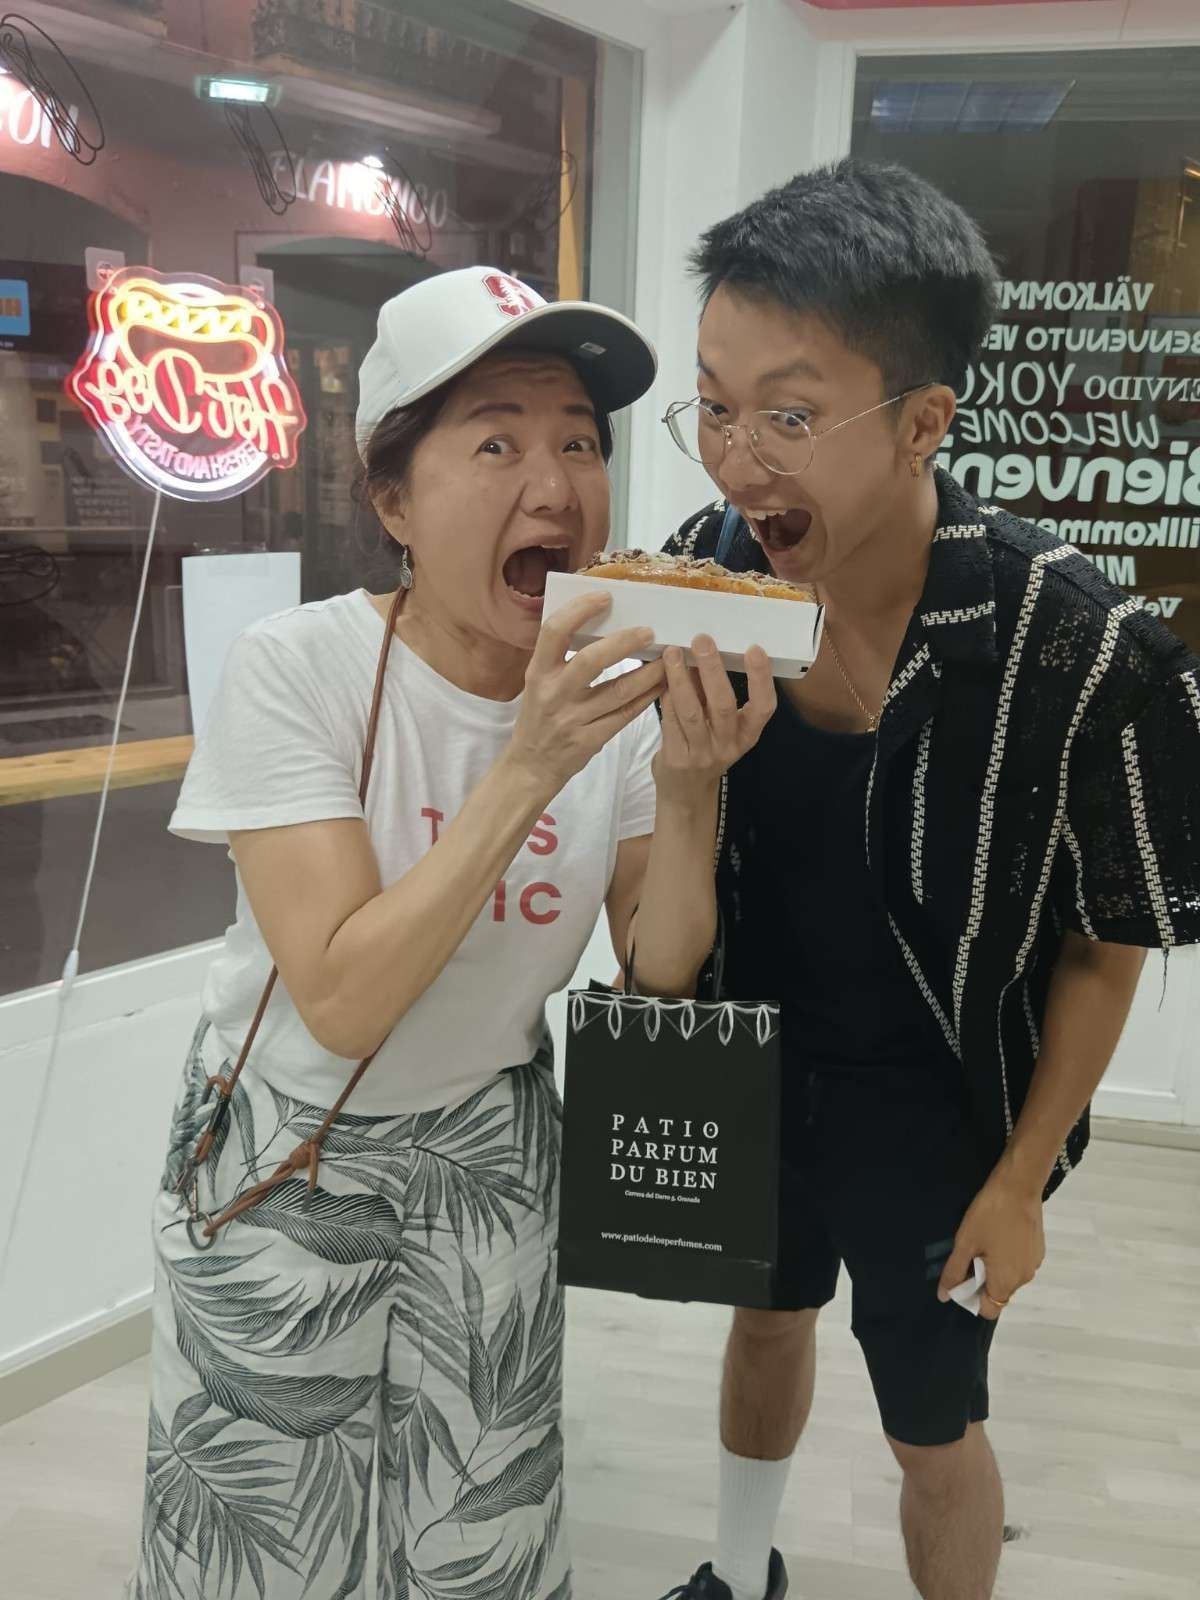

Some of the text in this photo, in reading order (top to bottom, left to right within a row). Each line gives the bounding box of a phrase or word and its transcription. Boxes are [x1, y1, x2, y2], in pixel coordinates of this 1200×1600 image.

[612, 1114, 719, 1139] PATIO
[611, 1138, 718, 1164] PARFUM
[610, 1163, 717, 1190] DU BIEN
[601, 1232, 722, 1252] www.patiodelosperfumes.com
